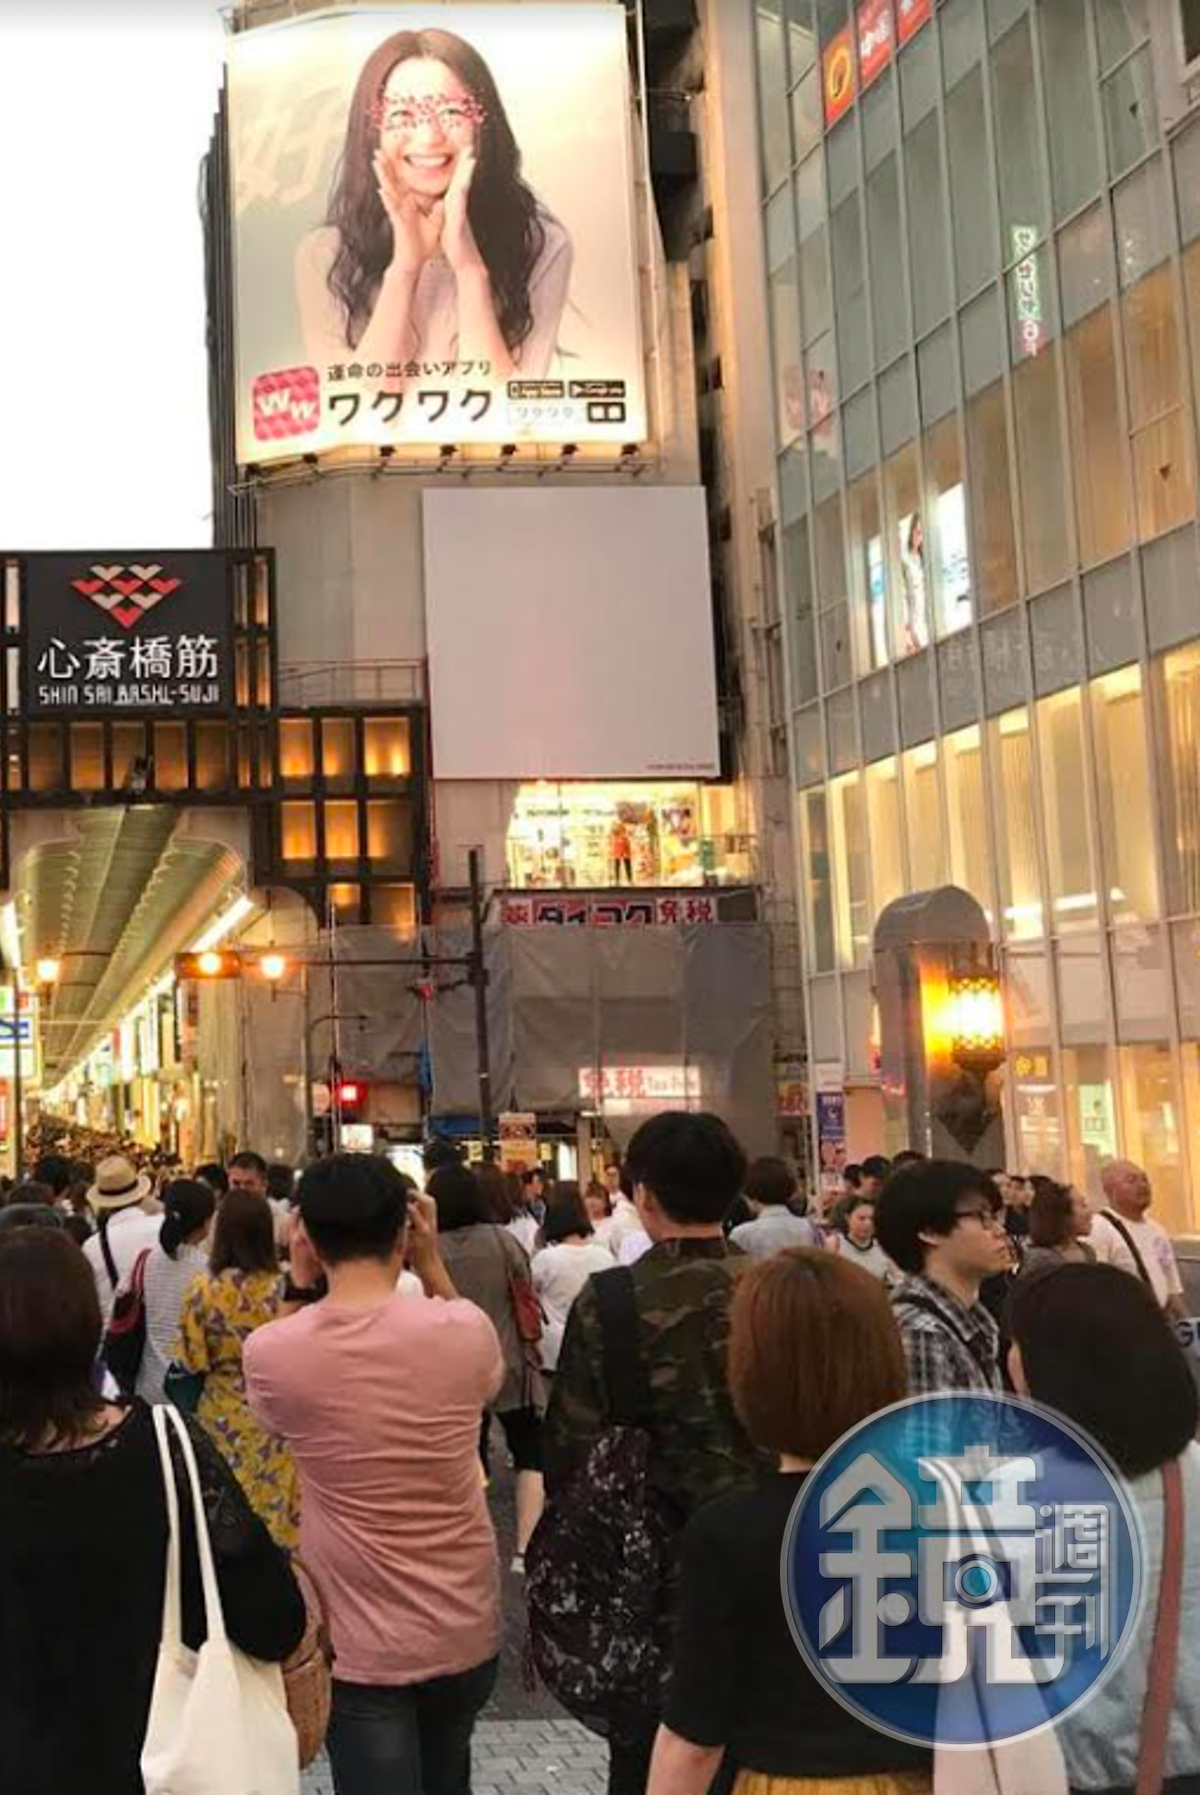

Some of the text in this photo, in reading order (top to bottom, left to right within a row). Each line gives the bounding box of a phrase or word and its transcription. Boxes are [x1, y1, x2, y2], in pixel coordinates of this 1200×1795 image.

[327, 359, 492, 383] 運命の出会いアプリ
[328, 389, 493, 427] ワクワク
[37, 635, 218, 680] 心斎橋筋
